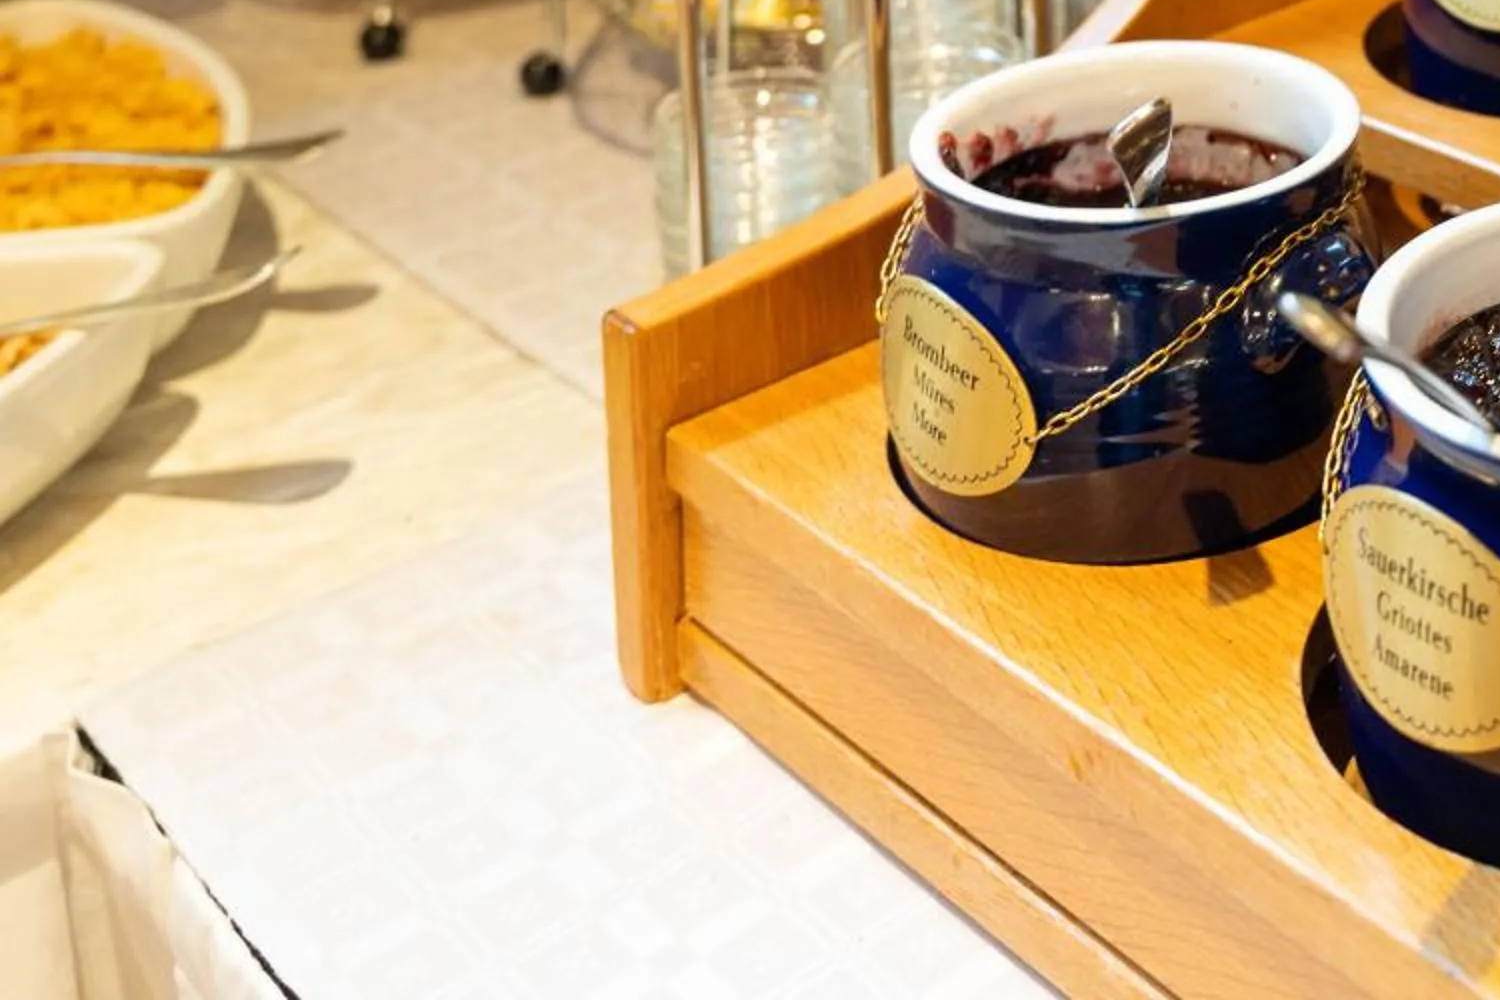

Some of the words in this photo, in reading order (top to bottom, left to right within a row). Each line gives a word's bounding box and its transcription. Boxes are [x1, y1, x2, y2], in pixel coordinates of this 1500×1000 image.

[903, 315, 981, 391] Brombeer
[912, 402, 948, 446] More
[1357, 526, 1491, 625] Sauerkirsche
[1376, 591, 1453, 654] Griottes
[1374, 632, 1454, 700] Amarene
